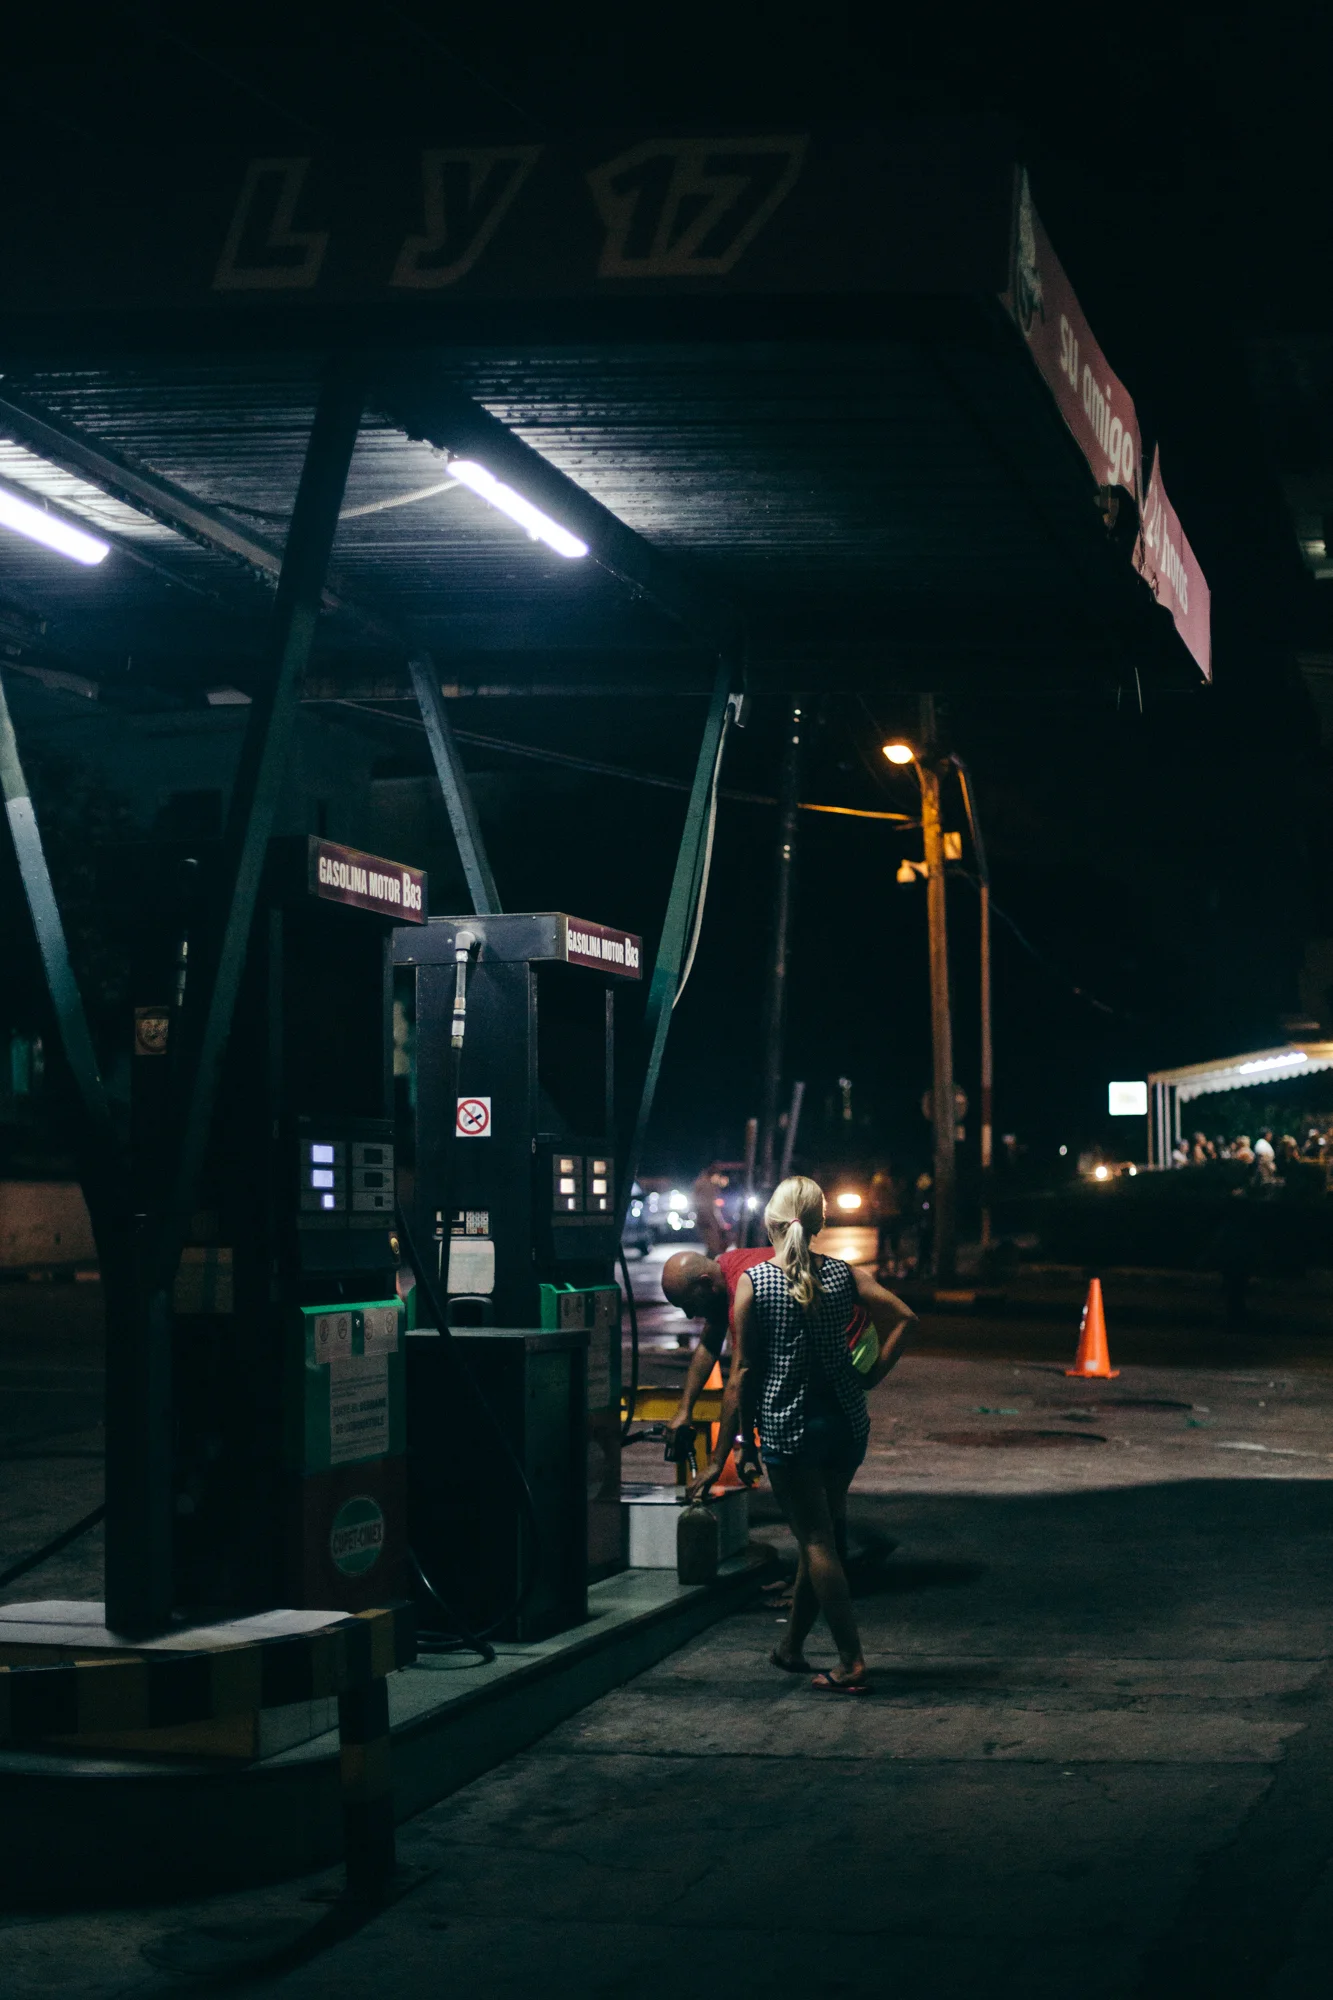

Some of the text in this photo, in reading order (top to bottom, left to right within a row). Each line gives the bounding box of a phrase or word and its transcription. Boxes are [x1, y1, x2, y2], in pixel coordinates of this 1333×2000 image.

[211, 156, 332, 291] L
[584, 132, 811, 280] 17
[1059, 313, 1134, 486] su amigo
[1160, 511, 1189, 616] horas
[319, 856, 422, 911] GASOLINA MOTOR B83
[568, 929, 639, 969] GASOLINA MOTOR B83
